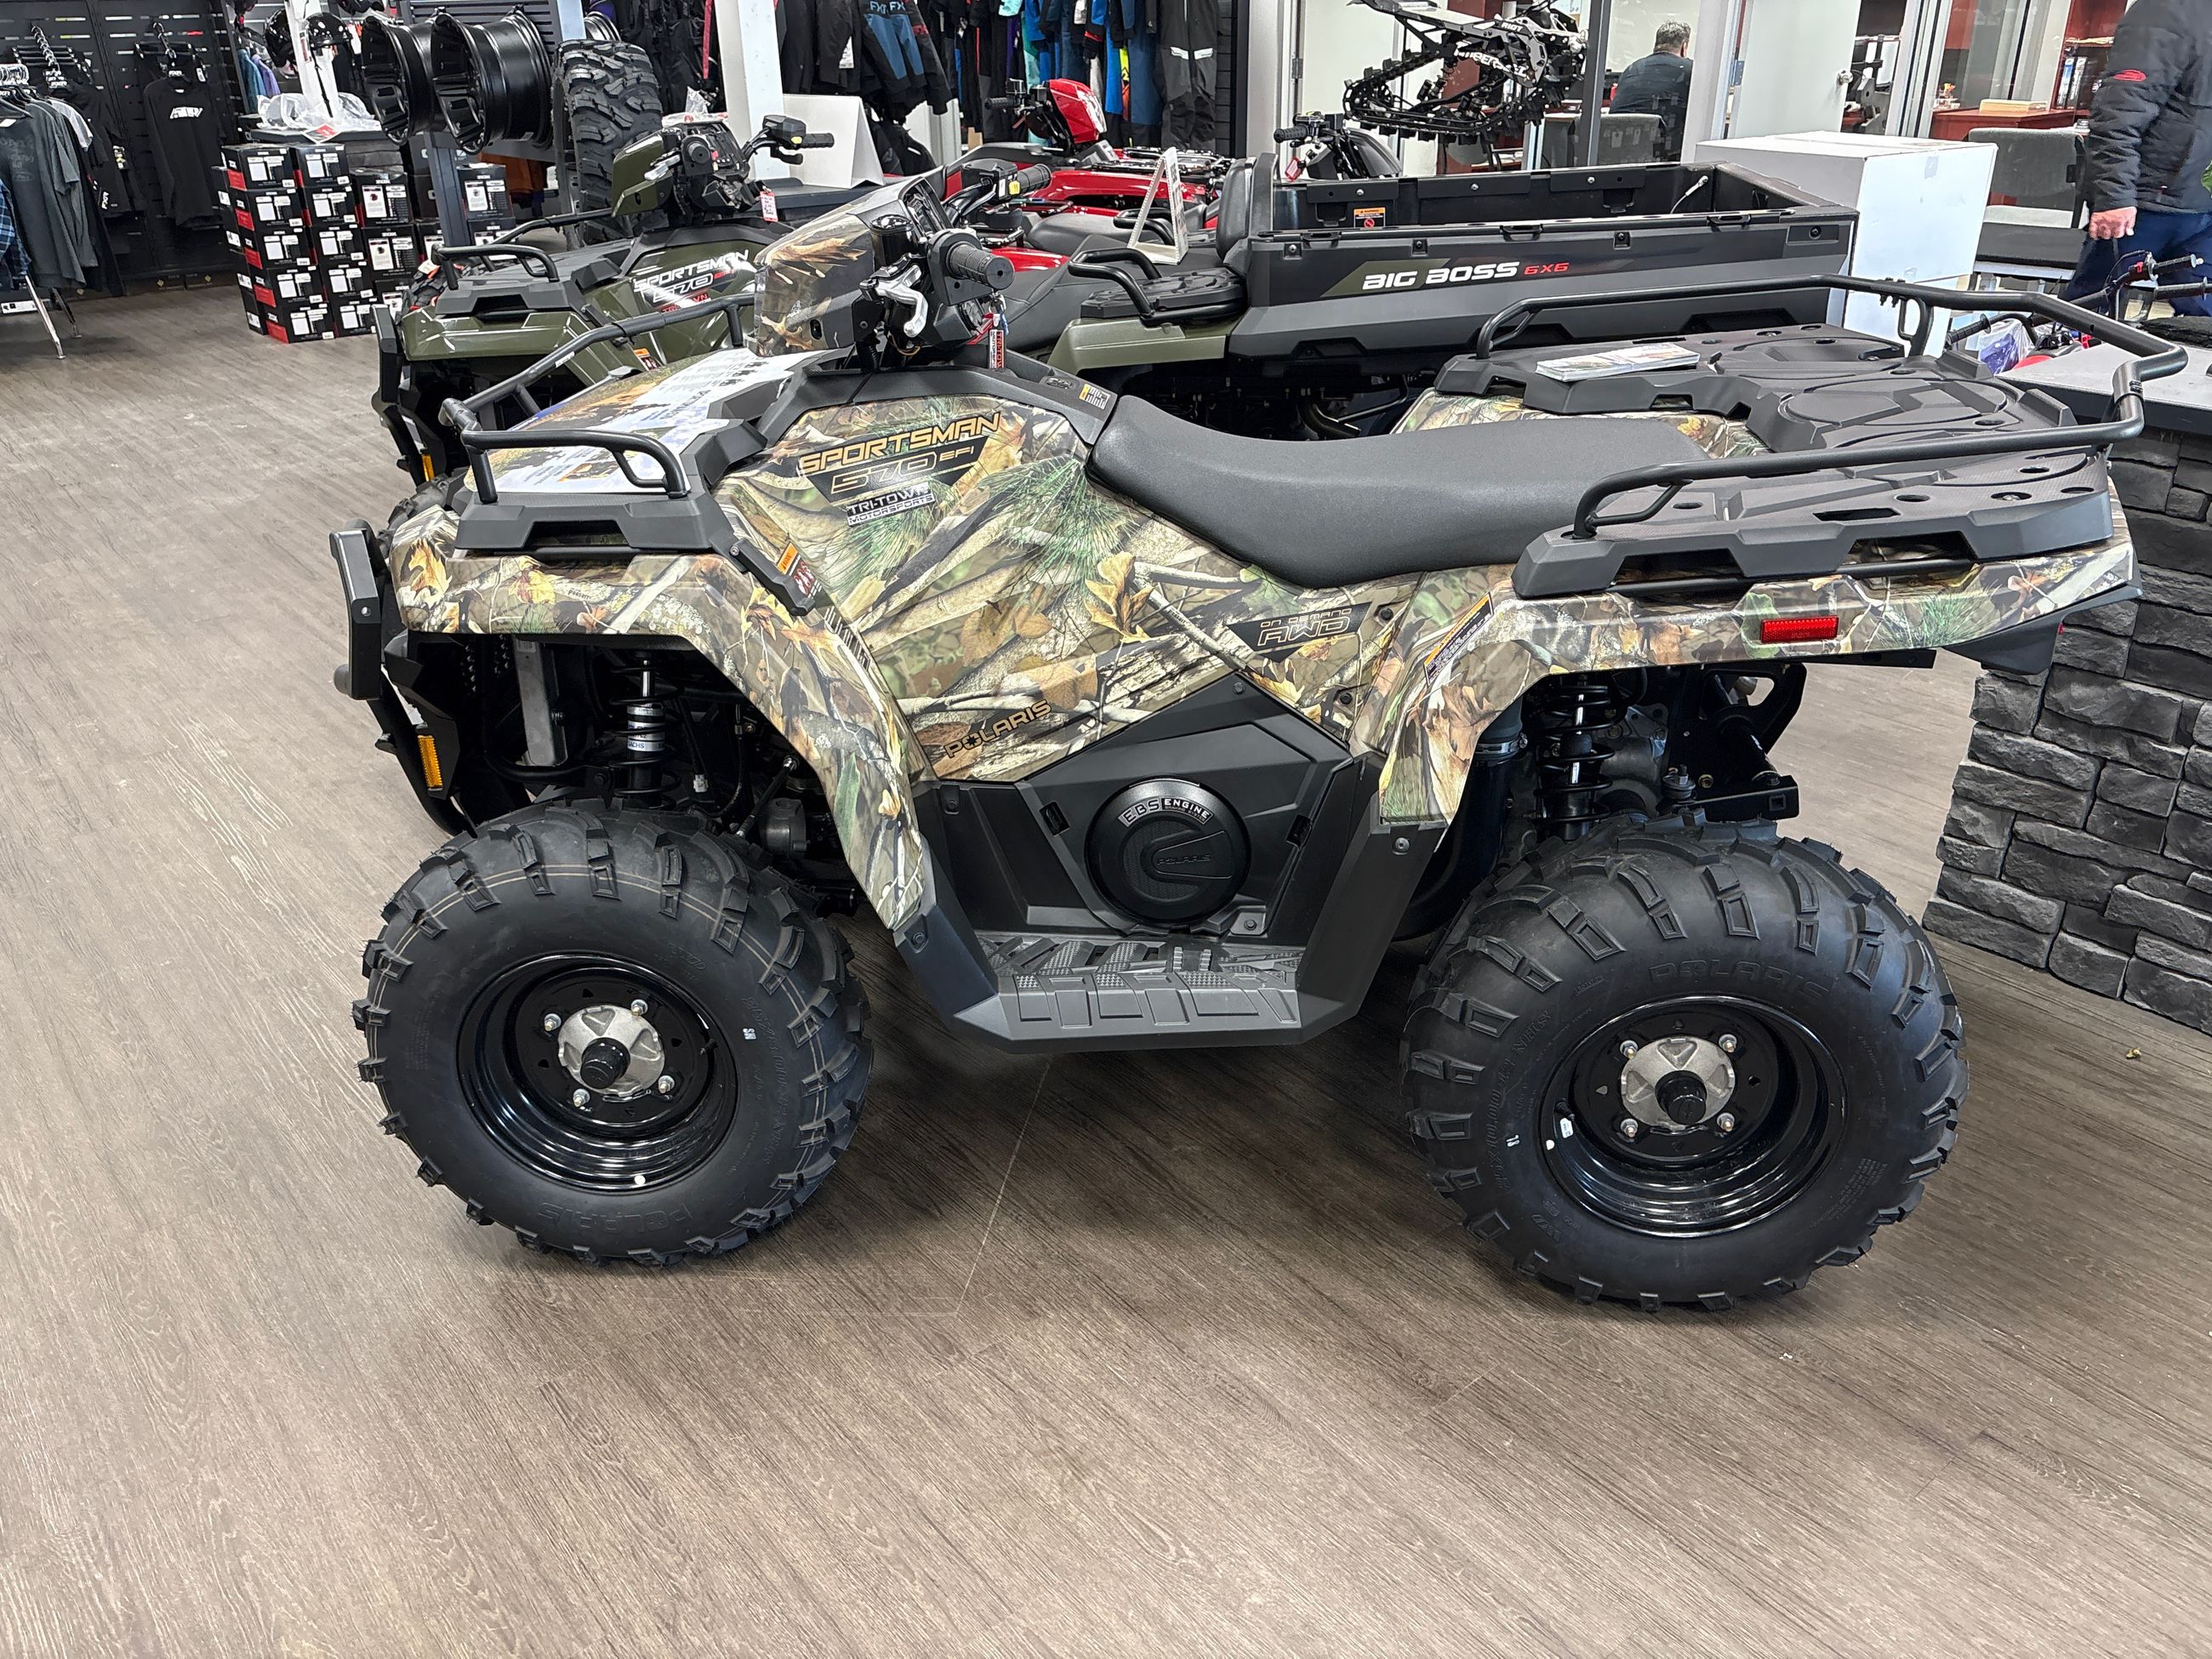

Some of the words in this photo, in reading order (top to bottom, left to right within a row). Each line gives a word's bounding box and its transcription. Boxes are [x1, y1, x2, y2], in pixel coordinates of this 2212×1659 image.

[1501, 21, 1524, 32] RIOT
[633, 248, 750, 293] SPORTSMAN
[1362, 271, 1418, 290] BIG
[1425, 261, 1520, 285] BOSS
[1524, 262, 1570, 276] 6X6
[653, 272, 714, 304] 570
[798, 411, 1001, 473] SPORTSMAN
[830, 451, 938, 495] 570
[938, 446, 975, 463] EFI
[847, 494, 934, 525] MOTORSPORTS
[848, 484, 930, 516] TRI-TOWN
[1257, 616, 1351, 647] AWD
[1260, 619, 1282, 629] ON
[1288, 607, 1353, 624] DEMAND
[943, 698, 1052, 759] POLARIS
[1123, 798, 1160, 823] EBS
[1164, 798, 1211, 819] ENGINE
[1157, 853, 1212, 866] POLARIS
[1647, 959, 1831, 1001] POLARIS
